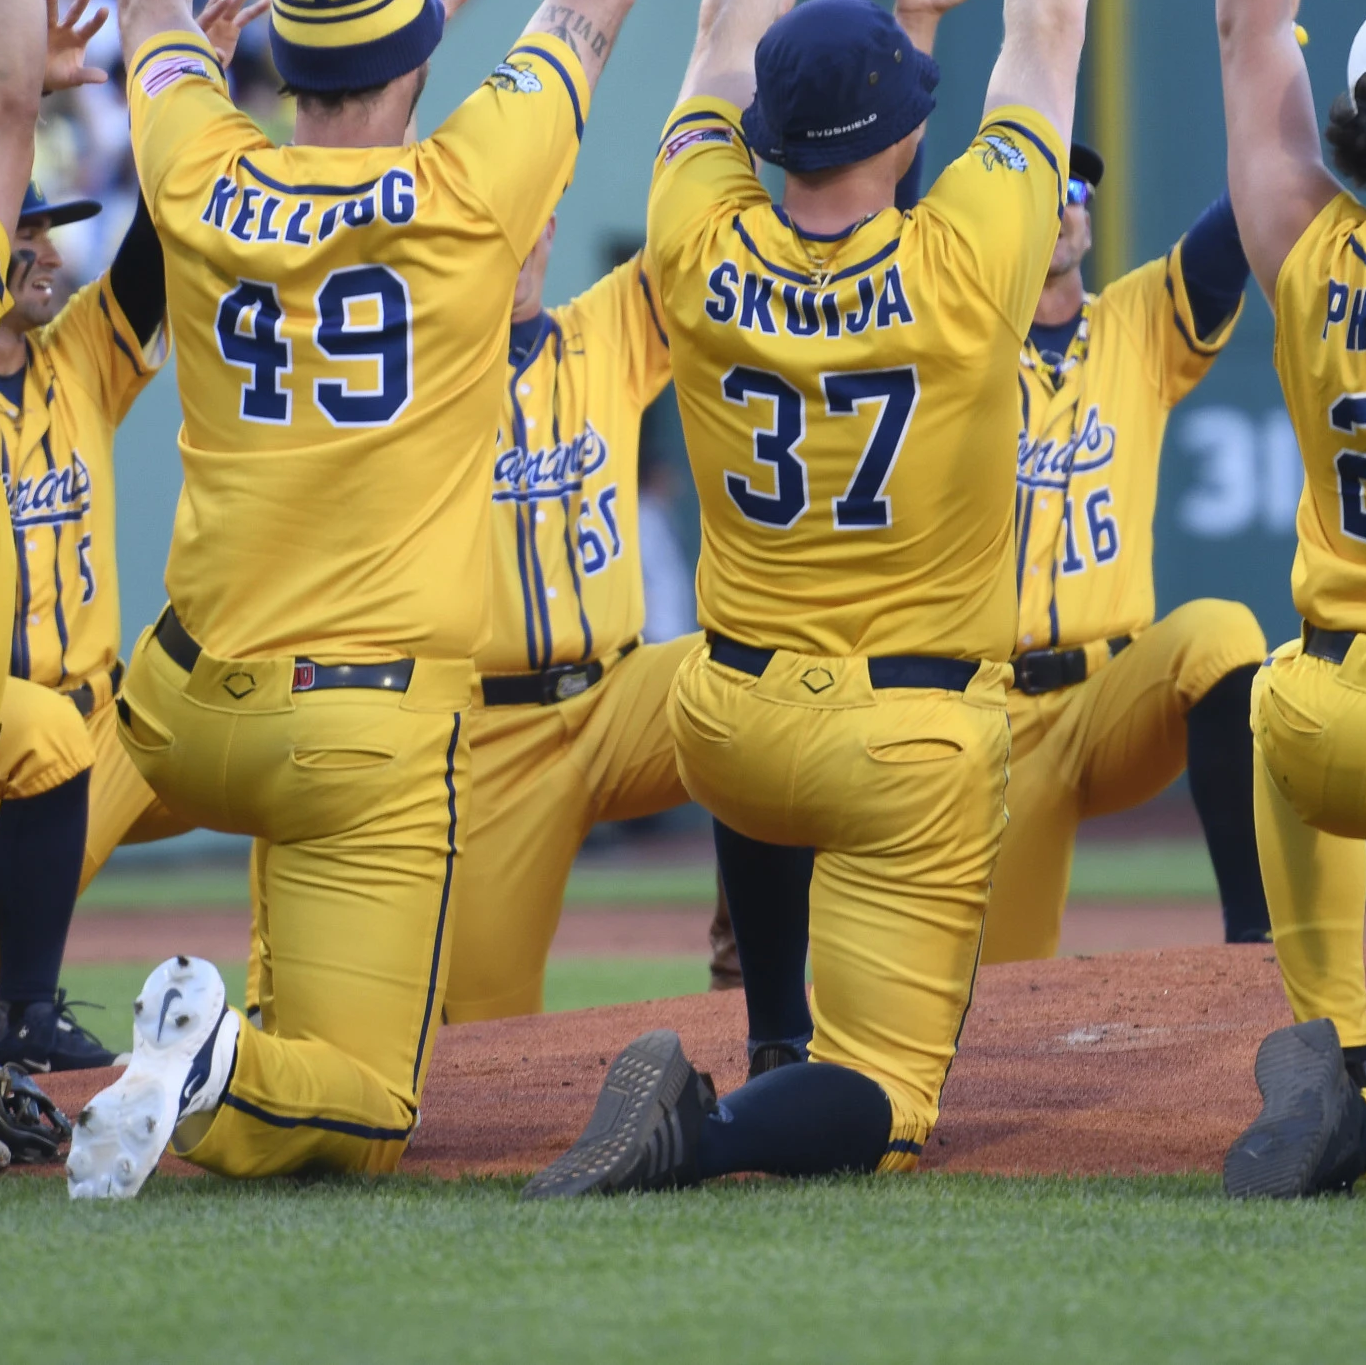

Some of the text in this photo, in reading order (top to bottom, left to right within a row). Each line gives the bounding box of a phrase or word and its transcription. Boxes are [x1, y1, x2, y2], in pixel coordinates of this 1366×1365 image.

[213, 262, 414, 429] 49
[704, 258, 916, 339] SKUIJA
[719, 362, 922, 531] 37
[1059, 487, 1122, 577] 16
